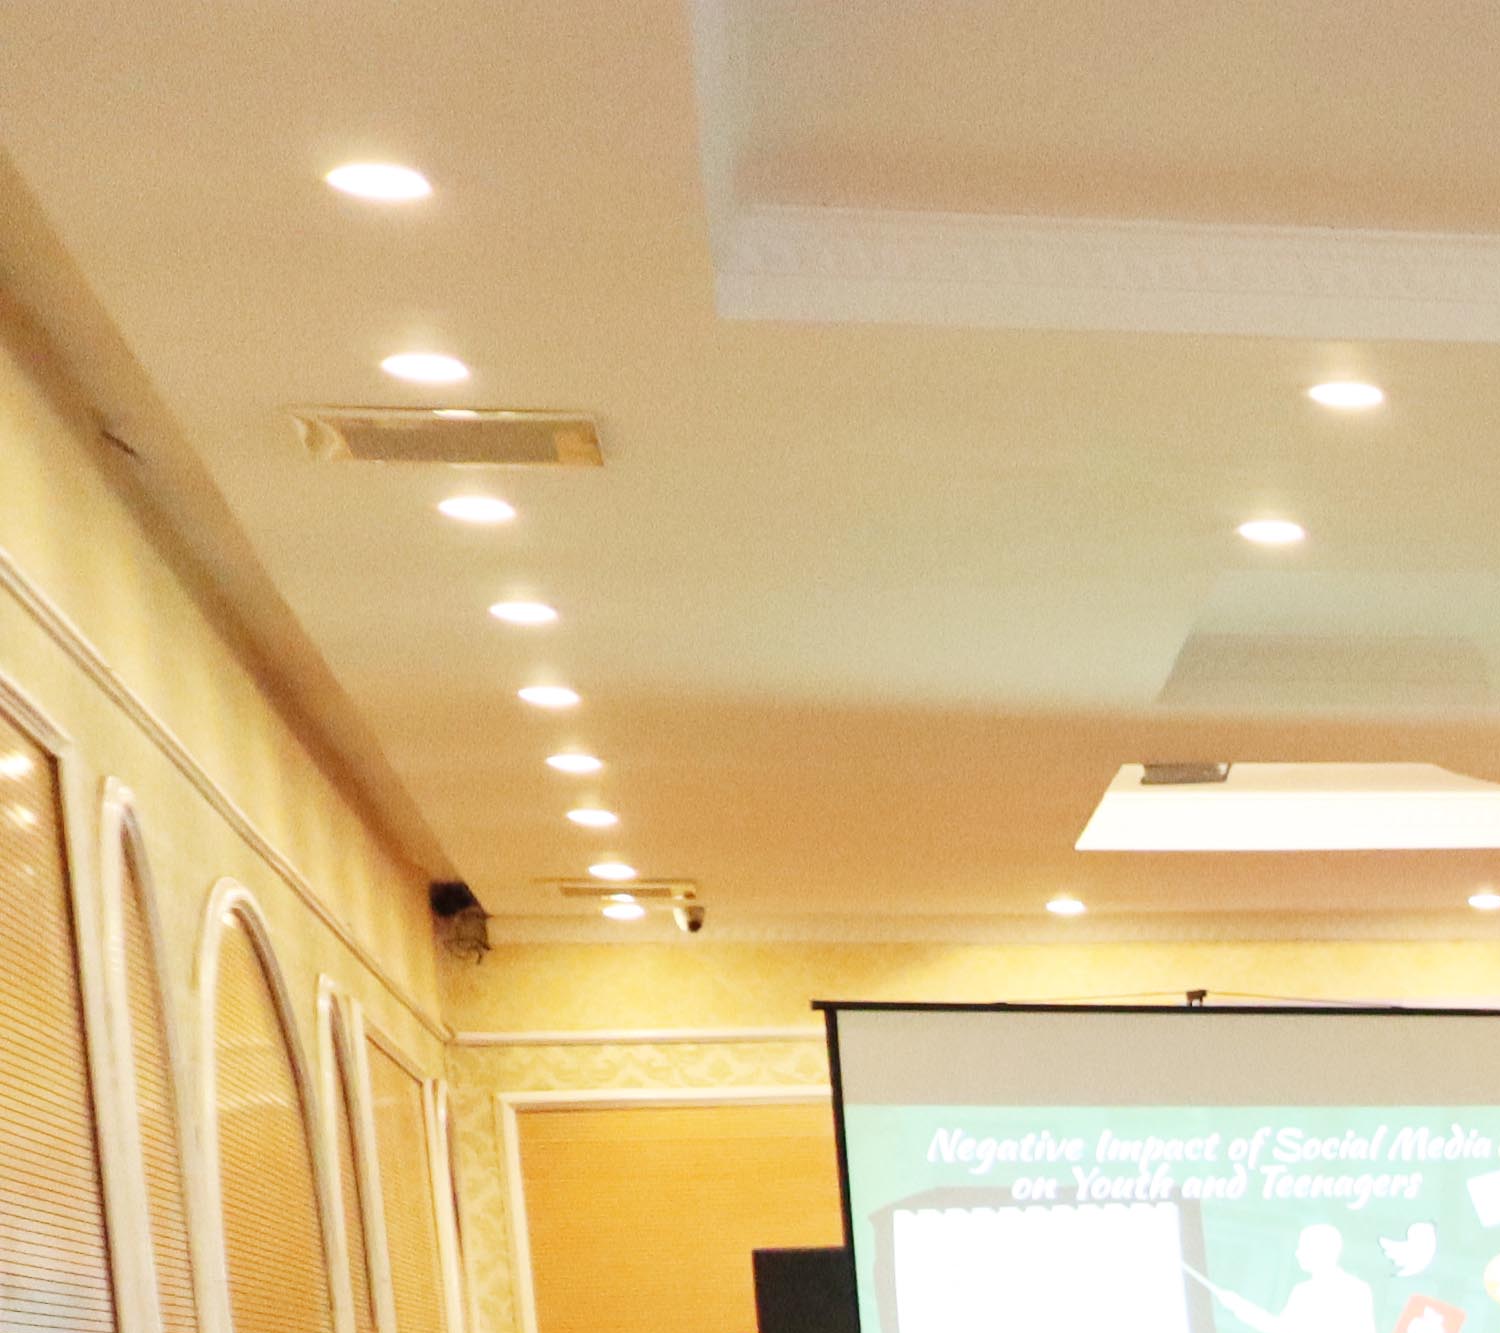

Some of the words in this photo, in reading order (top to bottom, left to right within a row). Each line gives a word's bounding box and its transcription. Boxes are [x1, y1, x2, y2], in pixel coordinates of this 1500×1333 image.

[927, 1127, 1083, 1175] Negative
[1095, 1130, 1219, 1172] Impact
[1228, 1127, 1270, 1170] of
[1272, 1125, 1388, 1161] Social
[1387, 1126, 1492, 1160] Media
[1010, 1172, 1057, 1201] on
[1071, 1166, 1174, 1201] Youth
[1181, 1166, 1248, 1200] and
[1261, 1165, 1424, 1210] Teenagers
